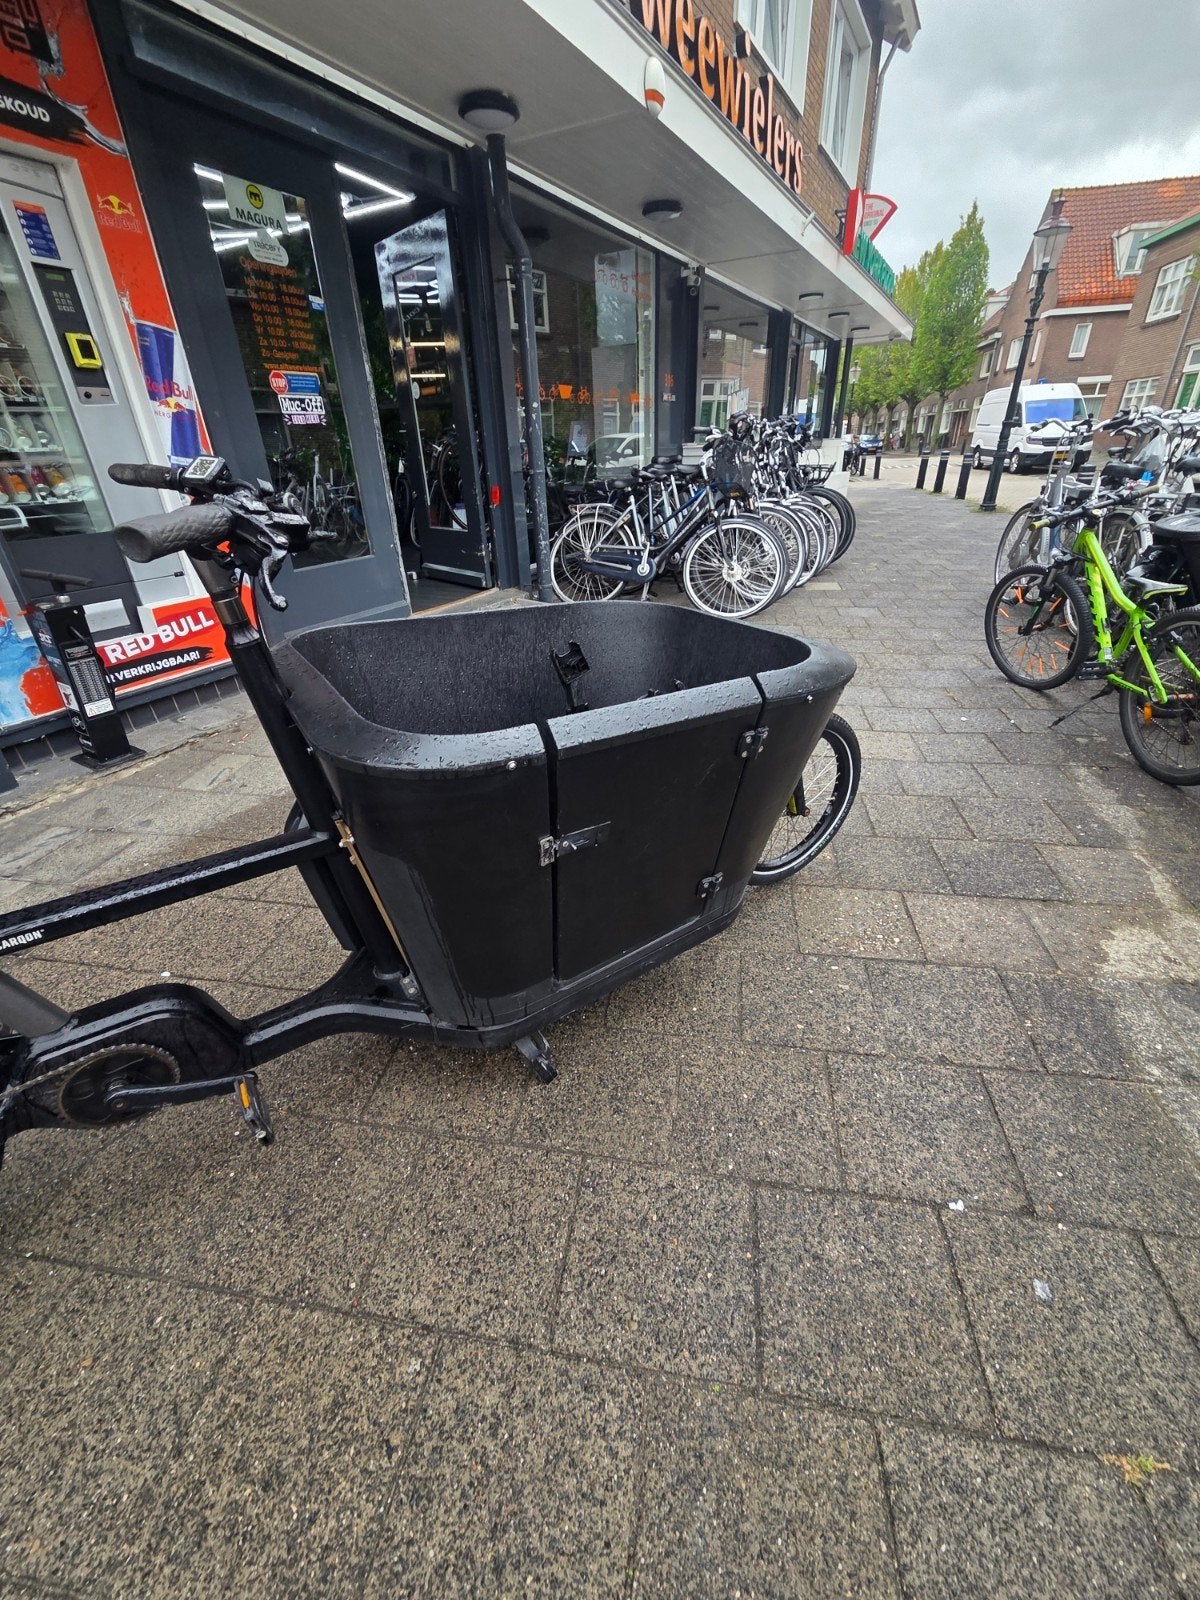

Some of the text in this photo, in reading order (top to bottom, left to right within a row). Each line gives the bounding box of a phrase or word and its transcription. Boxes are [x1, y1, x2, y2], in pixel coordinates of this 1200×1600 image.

[118, 215, 142, 233] Bull
[235, 207, 283, 231] MAGURA
[144, 375, 194, 402] Red Bull
[271, 377, 286, 388] STOP
[281, 396, 322, 412] Muc-Off
[104, 634, 155, 664] RED
[157, 611, 214, 644] BULL
[0, 930, 43, 950] ARQON
